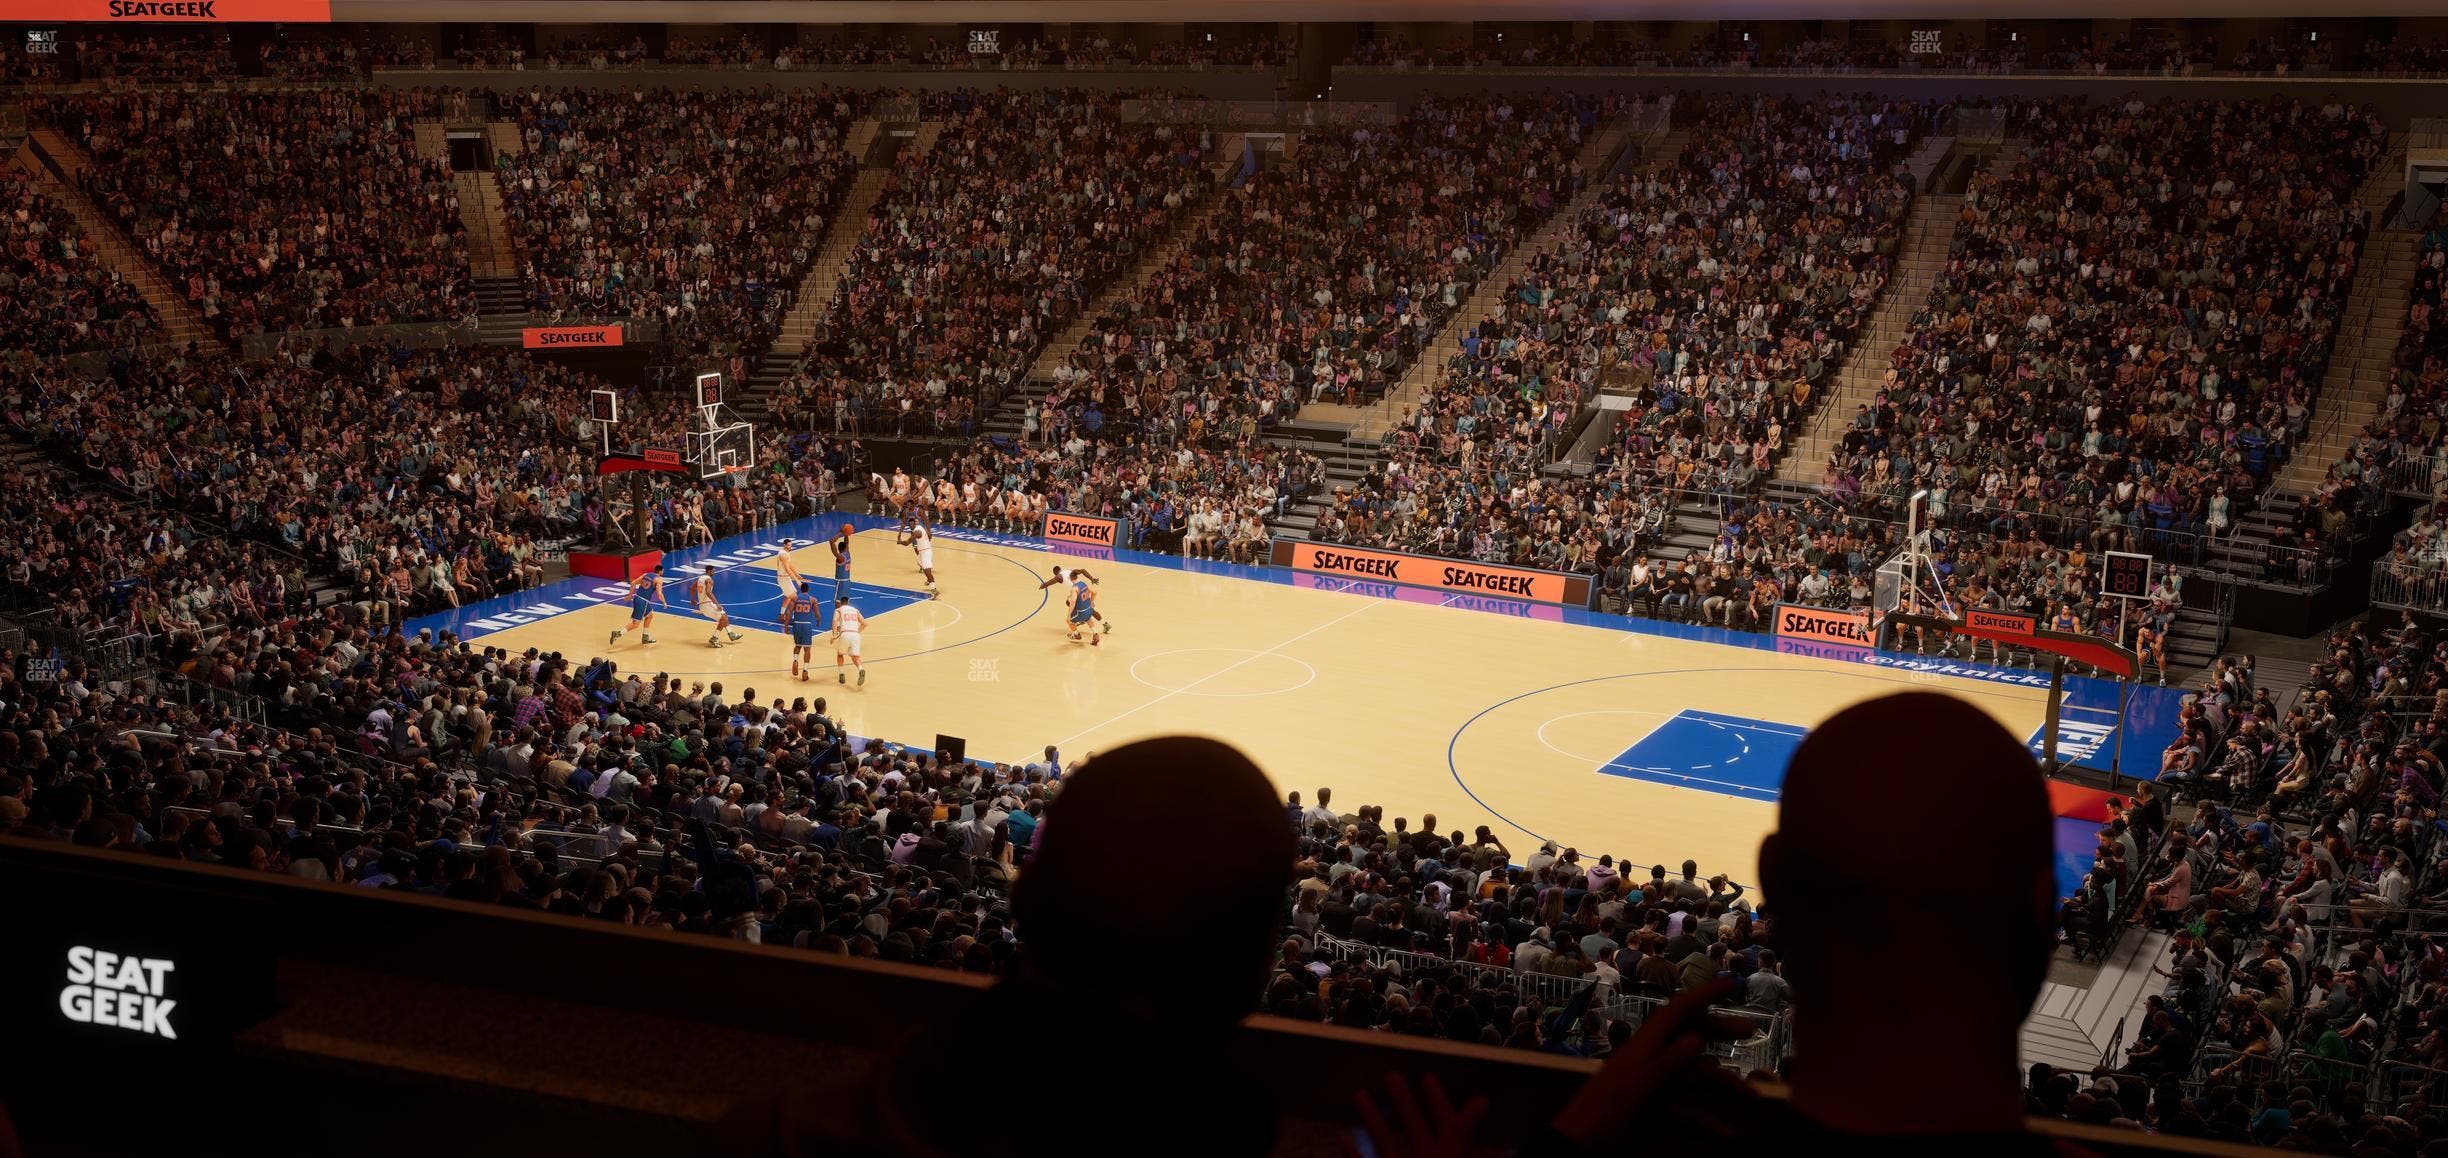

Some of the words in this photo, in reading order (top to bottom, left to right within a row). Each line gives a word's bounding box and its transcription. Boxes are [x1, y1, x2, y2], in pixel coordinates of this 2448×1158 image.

[110, 0, 216, 18] SEATGEEK
[541, 331, 606, 345] SEATGEEK
[647, 451, 676, 462] SEATGEEK
[1050, 519, 1111, 543] SEATGEEK
[1313, 550, 1400, 580] SEATGEEK
[1442, 567, 1535, 597] SEATGEEK
[465, 602, 568, 631] NEW
[1784, 613, 1870, 643] SEATGEEK
[1974, 614, 2026, 632] SEATGEEK
[67, 945, 175, 997] SEAT
[60, 984, 178, 1040] GEEK
